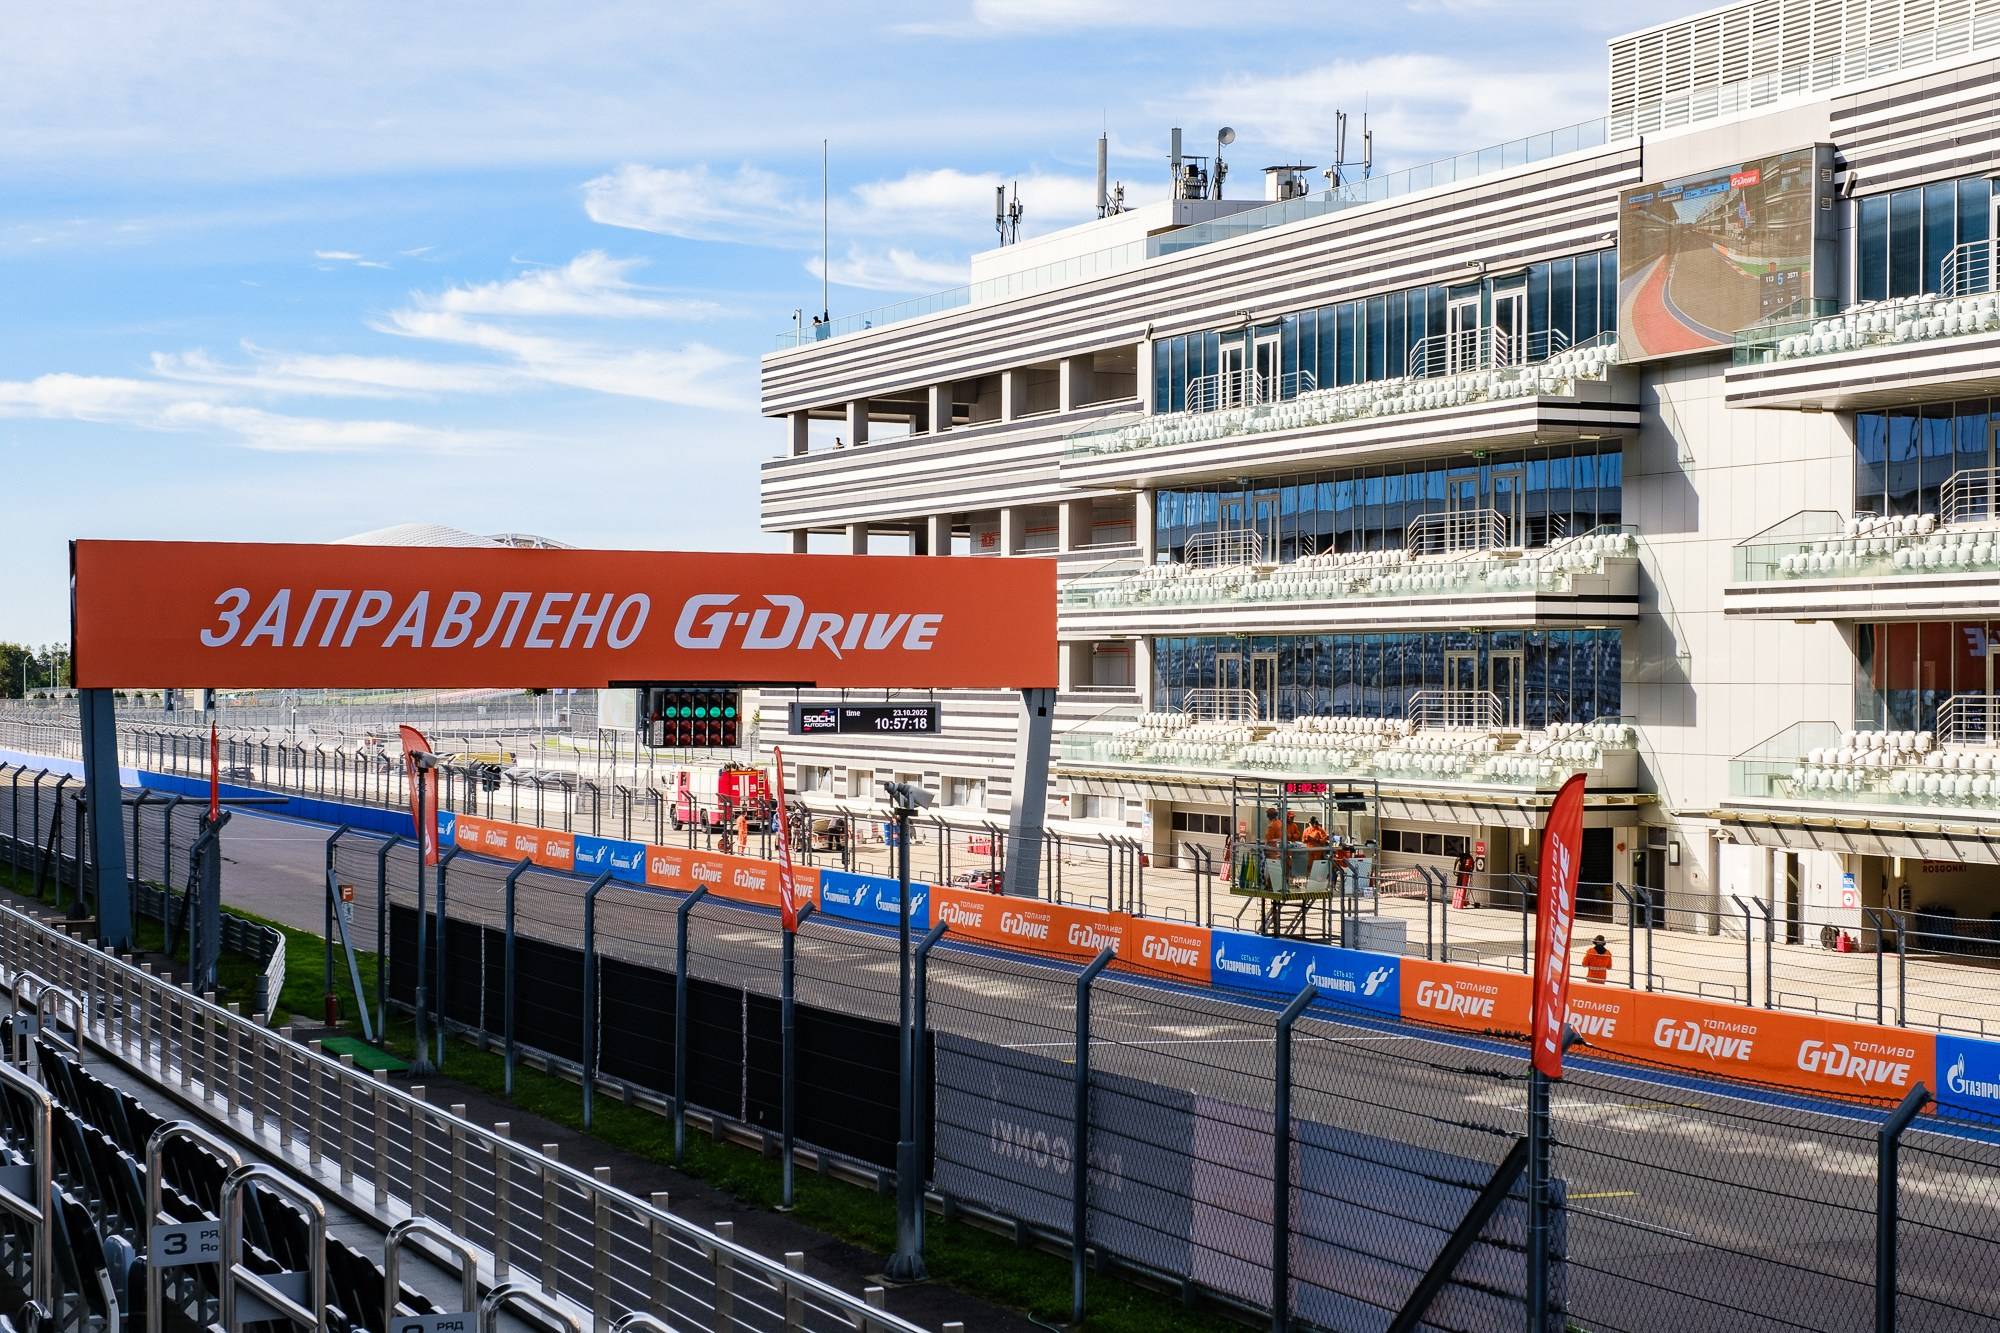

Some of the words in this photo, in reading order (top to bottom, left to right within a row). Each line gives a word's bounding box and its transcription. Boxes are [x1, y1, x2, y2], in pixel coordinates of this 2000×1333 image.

[200, 587, 651, 649] ЗАПРАВЛЕНО
[803, 715, 835, 723] SOCHI
[893, 709, 928, 717] 23.10.2022
[874, 718, 928, 730] 10:57:18
[1922, 865, 1967, 873] ROSGONKI
[343, 888, 352, 900] F
[960, 900, 985, 911] ТОПЛИВО
[1024, 911, 1050, 922] ТОПЛИВО
[1094, 923, 1123, 934] ТОПЛИВО
[1170, 935, 1202, 947] ТОПЛИВО
[1455, 980, 1498, 995] ТОПЛИВО
[1572, 998, 1620, 1014] ТОПЛИВО
[20, 1019, 28, 1030] 1
[1703, 1018, 1757, 1035] ТОПЛИВО
[1853, 1040, 1914, 1059] ТОПЛИВО
[1965, 1079, 2000, 1100] ГАЗПРО
[163, 1232, 188, 1256] 3
[200, 1229, 221, 1240] РЯ
[200, 1243, 219, 1253] Ro
[436, 1321, 464, 1332] РЯД
